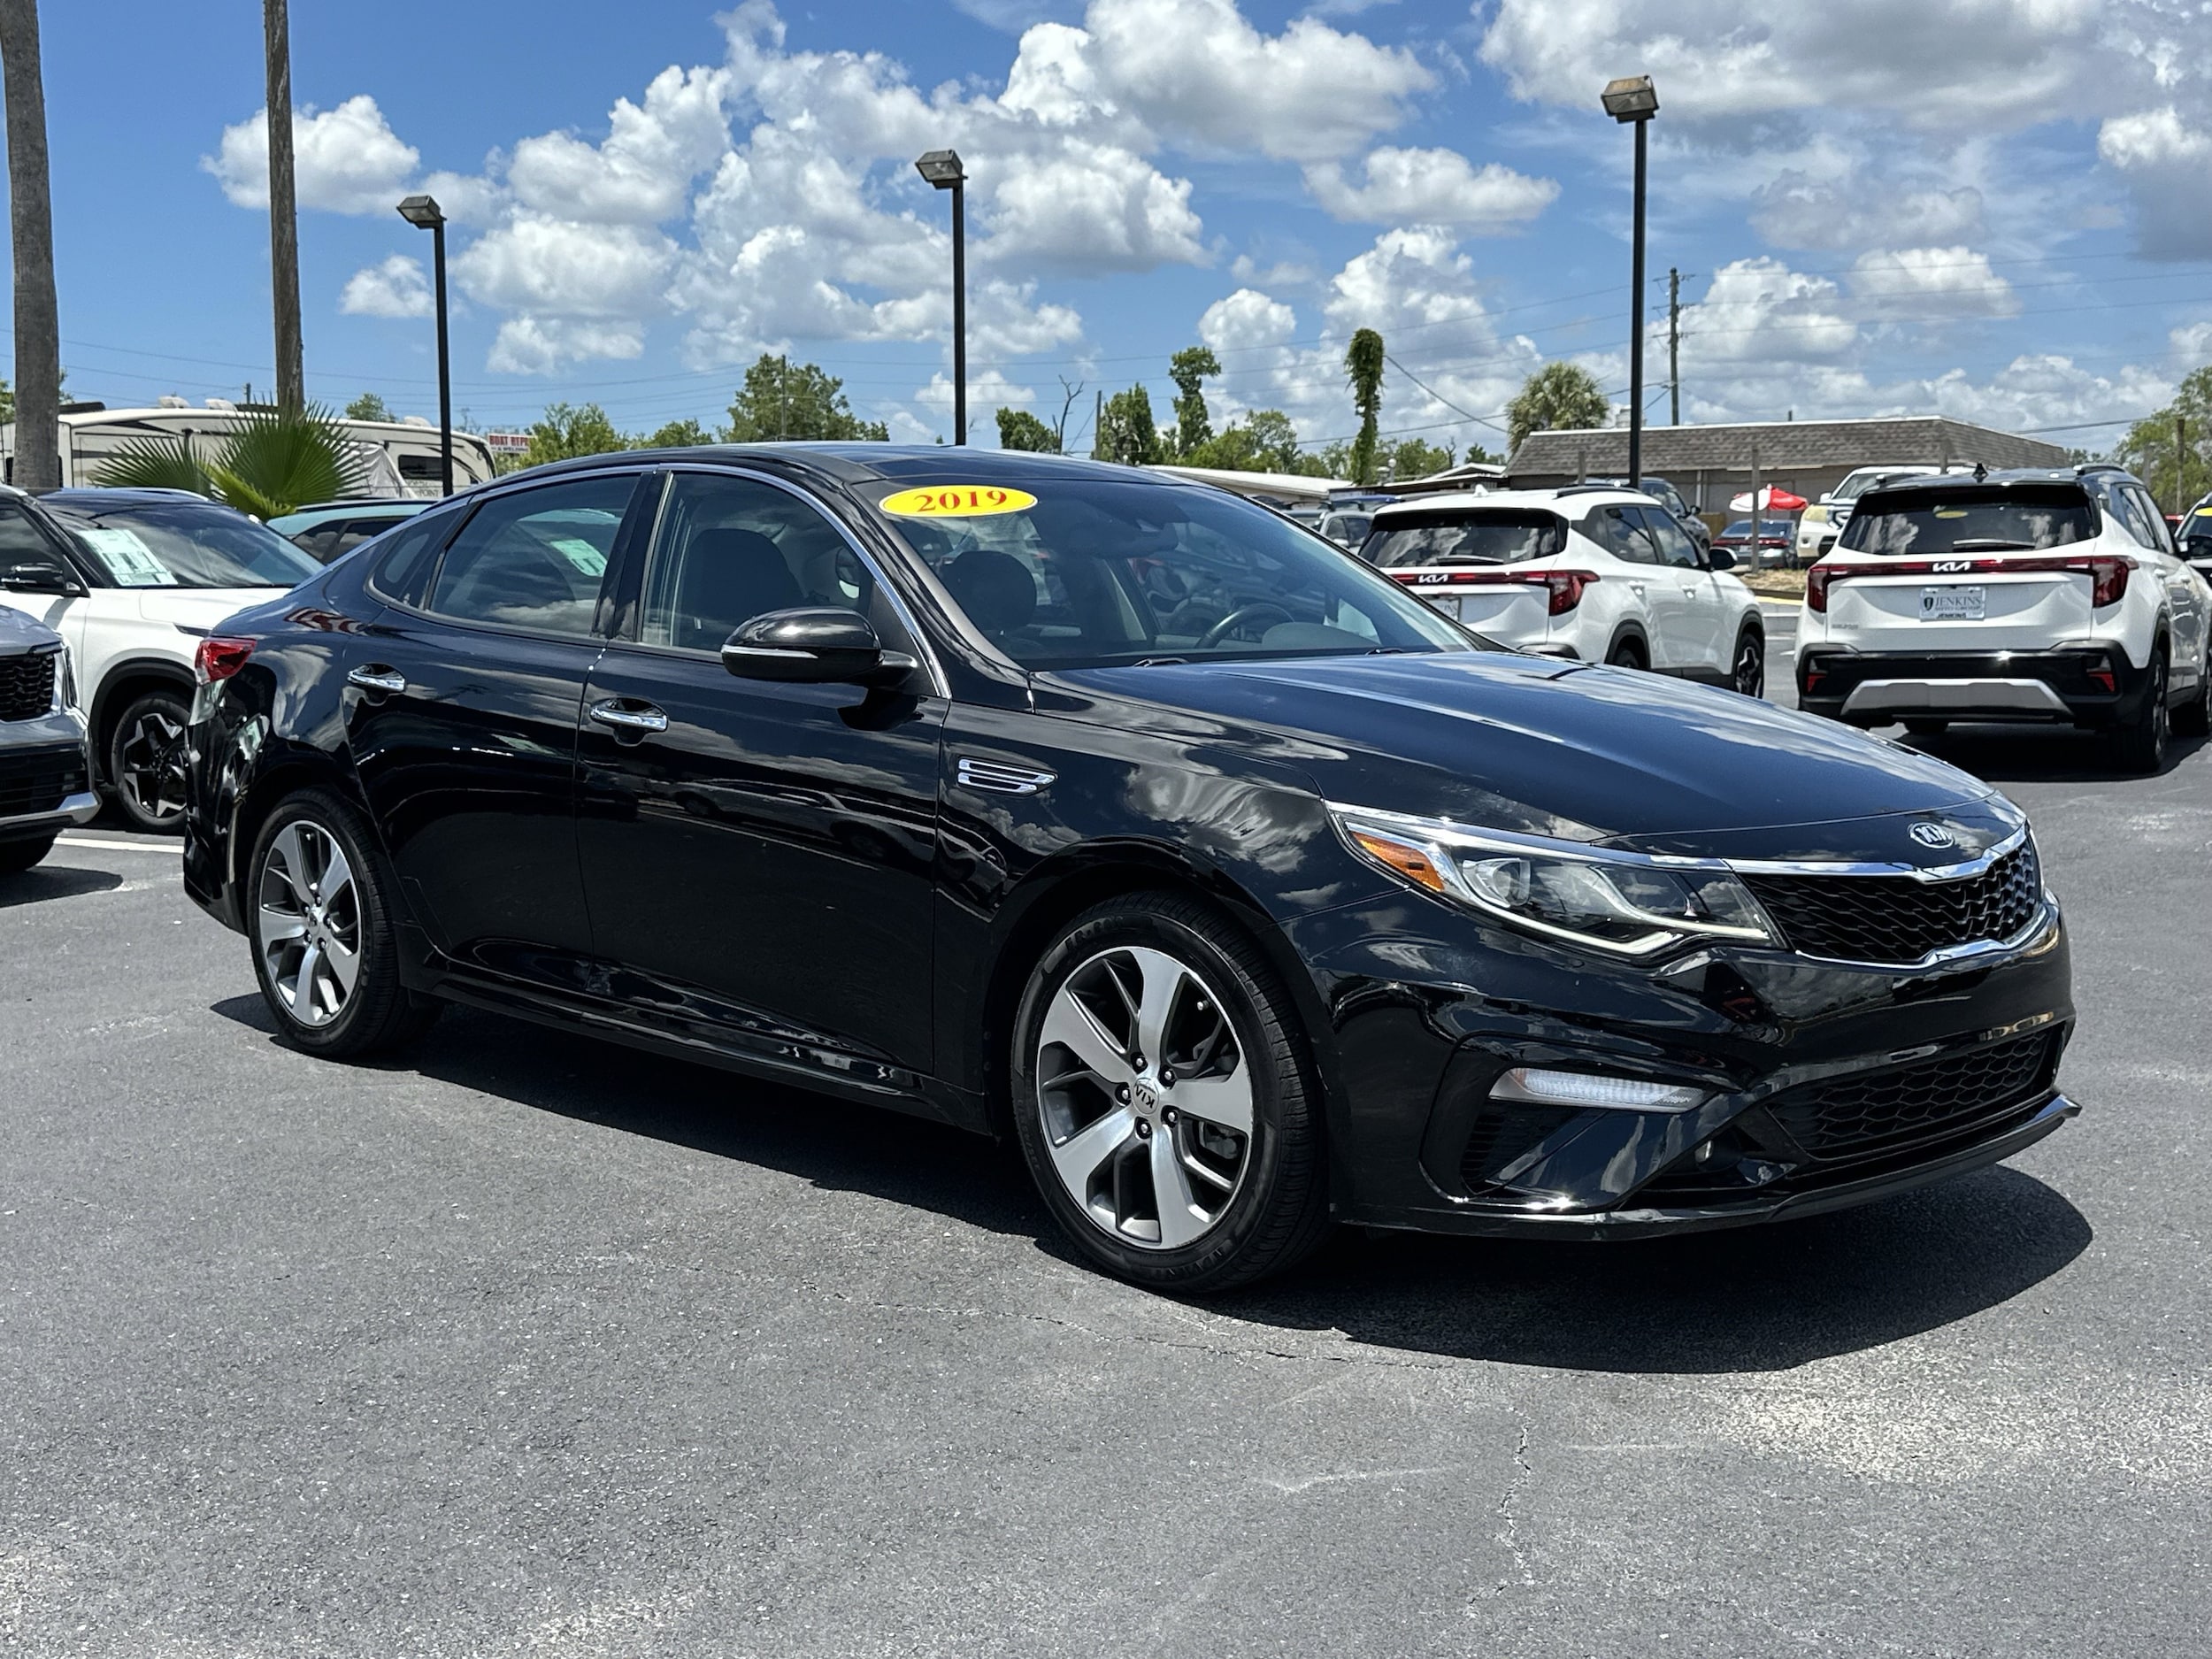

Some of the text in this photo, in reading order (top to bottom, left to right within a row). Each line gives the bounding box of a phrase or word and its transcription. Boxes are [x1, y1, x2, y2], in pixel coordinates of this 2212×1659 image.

[914, 490, 1007, 512] 2019
[1932, 561, 1971, 572] KIA
[1418, 574, 1448, 583] KIA
[1935, 595, 1982, 606] JENKINS
[1913, 825, 1953, 845] KIA
[1135, 1085, 1156, 1109] KIA
